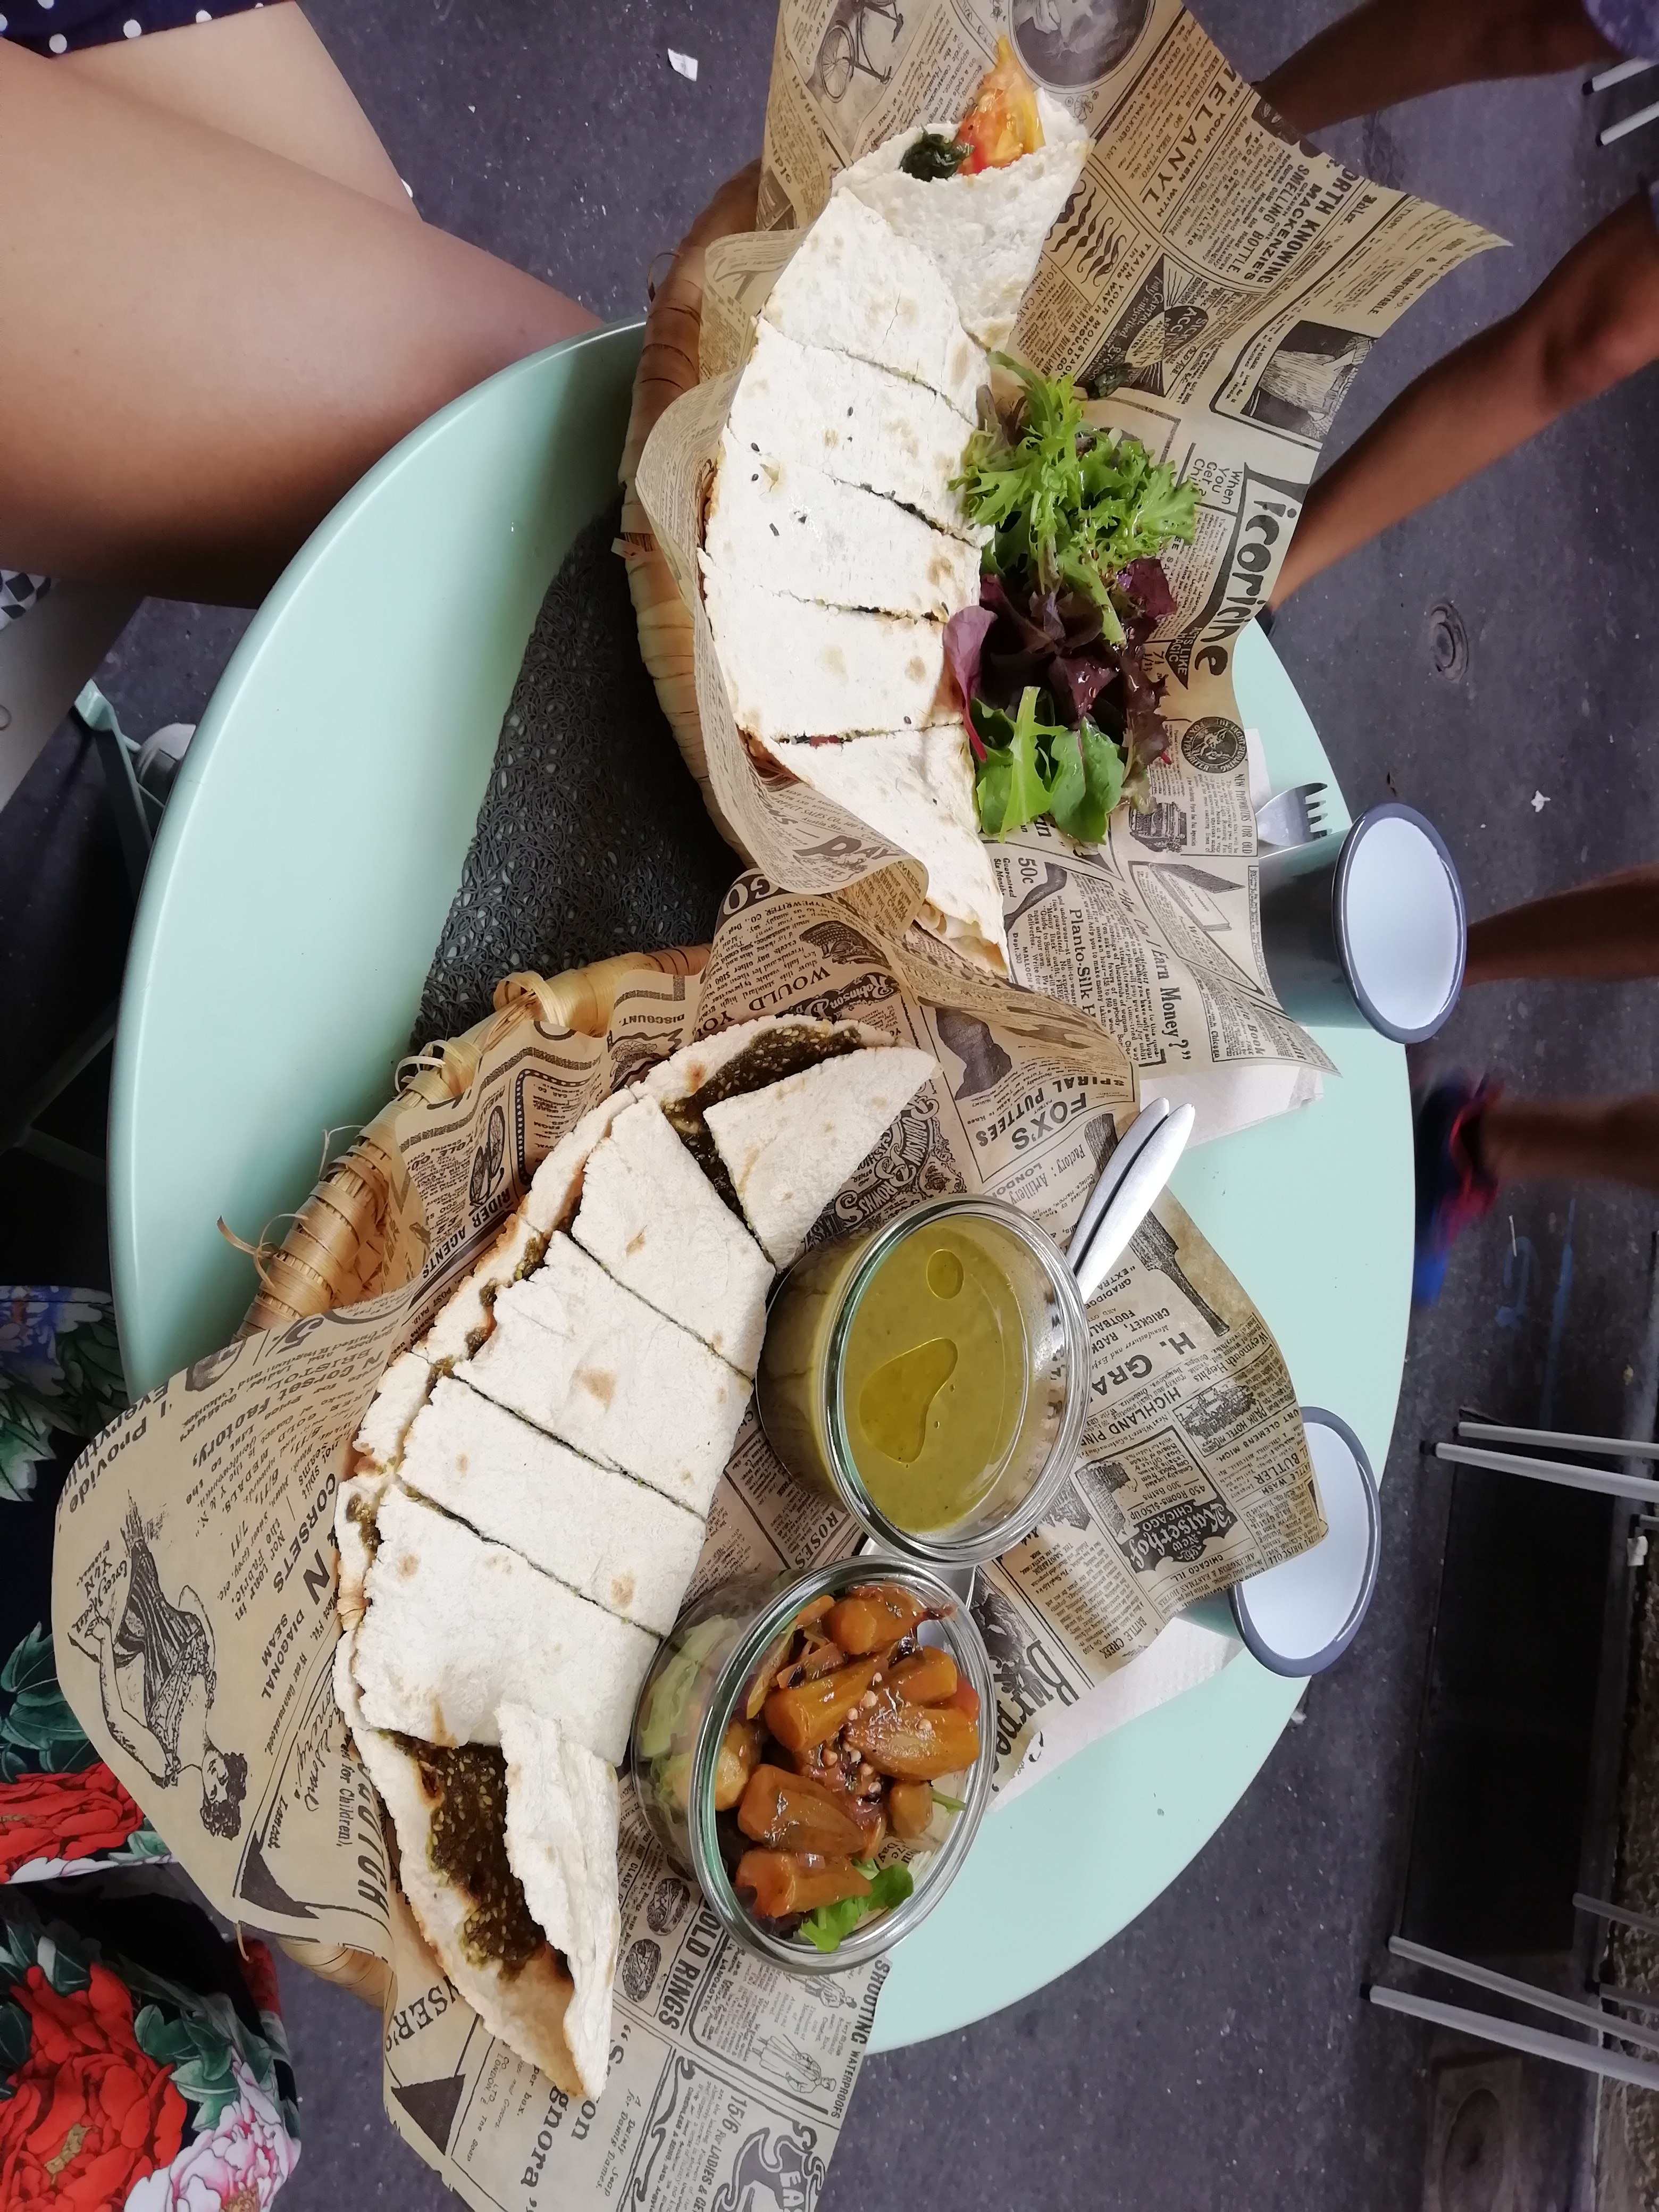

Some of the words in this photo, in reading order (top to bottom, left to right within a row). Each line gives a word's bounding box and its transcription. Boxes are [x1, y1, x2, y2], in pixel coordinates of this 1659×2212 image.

[1201, 111, 1227, 145] YOUR
[1176, 146, 1204, 183] LINEN
[1154, 187, 1178, 218] WITH
[1261, 162, 1310, 225] SMELLING
[1243, 182, 1323, 283] MACKENZIE'S
[1121, 241, 1152, 282] TRAIN
[1226, 228, 1264, 276] BOTTLE.
[1258, 216, 1320, 289] KNOWING
[1099, 279, 1118, 304] WAY
[1100, 282, 1125, 317] YOUR
[1133, 290, 1164, 329] CAPITAL
[1065, 314, 1096, 357] SHOULD
[1210, 465, 1230, 496] You
[1221, 469, 1243, 506] When
[1178, 648, 1191, 676] LIKE
[1234, 773, 1245, 787] NEW
[1241, 825, 1252, 838] FOR
[1241, 842, 1252, 854] OLD
[1001, 857, 1016, 898] Guaranteed
[1017, 855, 1039, 885] 50c
[1066, 908, 1094, 1000] Planto-Silk
[1149, 946, 1172, 981] Earn
[745, 964, 831, 1013] WOULD
[778, 969, 794, 983] this
[828, 974, 893, 1009] Robinson
[1209, 1029, 1222, 1059] Chicago
[1243, 1022, 1266, 1058] Book
[1051, 1071, 1125, 1093] SPIRAL
[972, 1087, 1048, 1147] PUTTEES
[1007, 1091, 1091, 1150] FOX'S
[466, 1185, 516, 1230] RIDER
[1007, 1172, 1050, 1208] Artillery
[416, 1224, 471, 1281] AGENTS
[1123, 1305, 1170, 1335] CRICKET,
[1159, 1329, 1195, 1362] H.
[1224, 1330, 1269, 1369] Weymouth
[264, 1347, 374, 1393] BRISTOL,
[275, 1361, 354, 1405] Corset
[1192, 1358, 1228, 1387] Heights
[1107, 1386, 1181, 1438] HIGHLAND
[1224, 1419, 1249, 1440] HOTEL
[1245, 1405, 1268, 1427] PARK
[187, 1393, 275, 1473] Factory,
[69, 1421, 149, 1515] Provide
[219, 1446, 271, 1515] MEDALS.
[298, 1463, 325, 1502] split
[1166, 1479, 1181, 1492] 300
[1252, 1452, 1301, 1486] BUTLER
[1142, 1486, 1166, 1502] Baths
[1187, 1481, 1206, 1497] 450
[1258, 1477, 1287, 1497] WASH.
[262, 1517, 282, 1545] the
[269, 1471, 341, 1595] CORSETS
[1128, 1510, 1142, 1522] Up
[1140, 1501, 1193, 1534] CHICAGO
[266, 1529, 288, 1563] Nor
[791, 1509, 841, 1572] ROSES
[1129, 1501, 1232, 1569] Kaiserhof
[1170, 1531, 1199, 1553] New
[229, 1547, 266, 1606] Fabric.
[303, 1549, 330, 1605] N
[1187, 1552, 1223, 1576] CHICAGO
[1216, 1550, 1255, 1574] ARLINGTON
[246, 1562, 271, 1602] tear
[1179, 1571, 1212, 1594] EASTMAN
[232, 1601, 249, 1623] in
[1121, 1615, 1149, 1641] BATTLE
[261, 1612, 290, 1668] SEAM
[261, 1607, 306, 1700] DIAGONAL
[1097, 1635, 1126, 1661] CREEK
[655, 1958, 702, 2031] RINGS
[850, 1958, 891, 2046] SHOOTING
[633, 2096, 644, 2107] A
[830, 2049, 861, 2119] WATERPROOFS
[516, 2091, 533, 2118] box.
[719, 2094, 749, 2134] 15/6
[465, 2139, 480, 2163] Soap
[616, 2118, 637, 2156] Dainty
[593, 2149, 616, 2191] Dames.
[602, 2166, 621, 2198] Soap
[700, 2144, 723, 2185] LADIES
[698, 2184, 709, 2195] &
